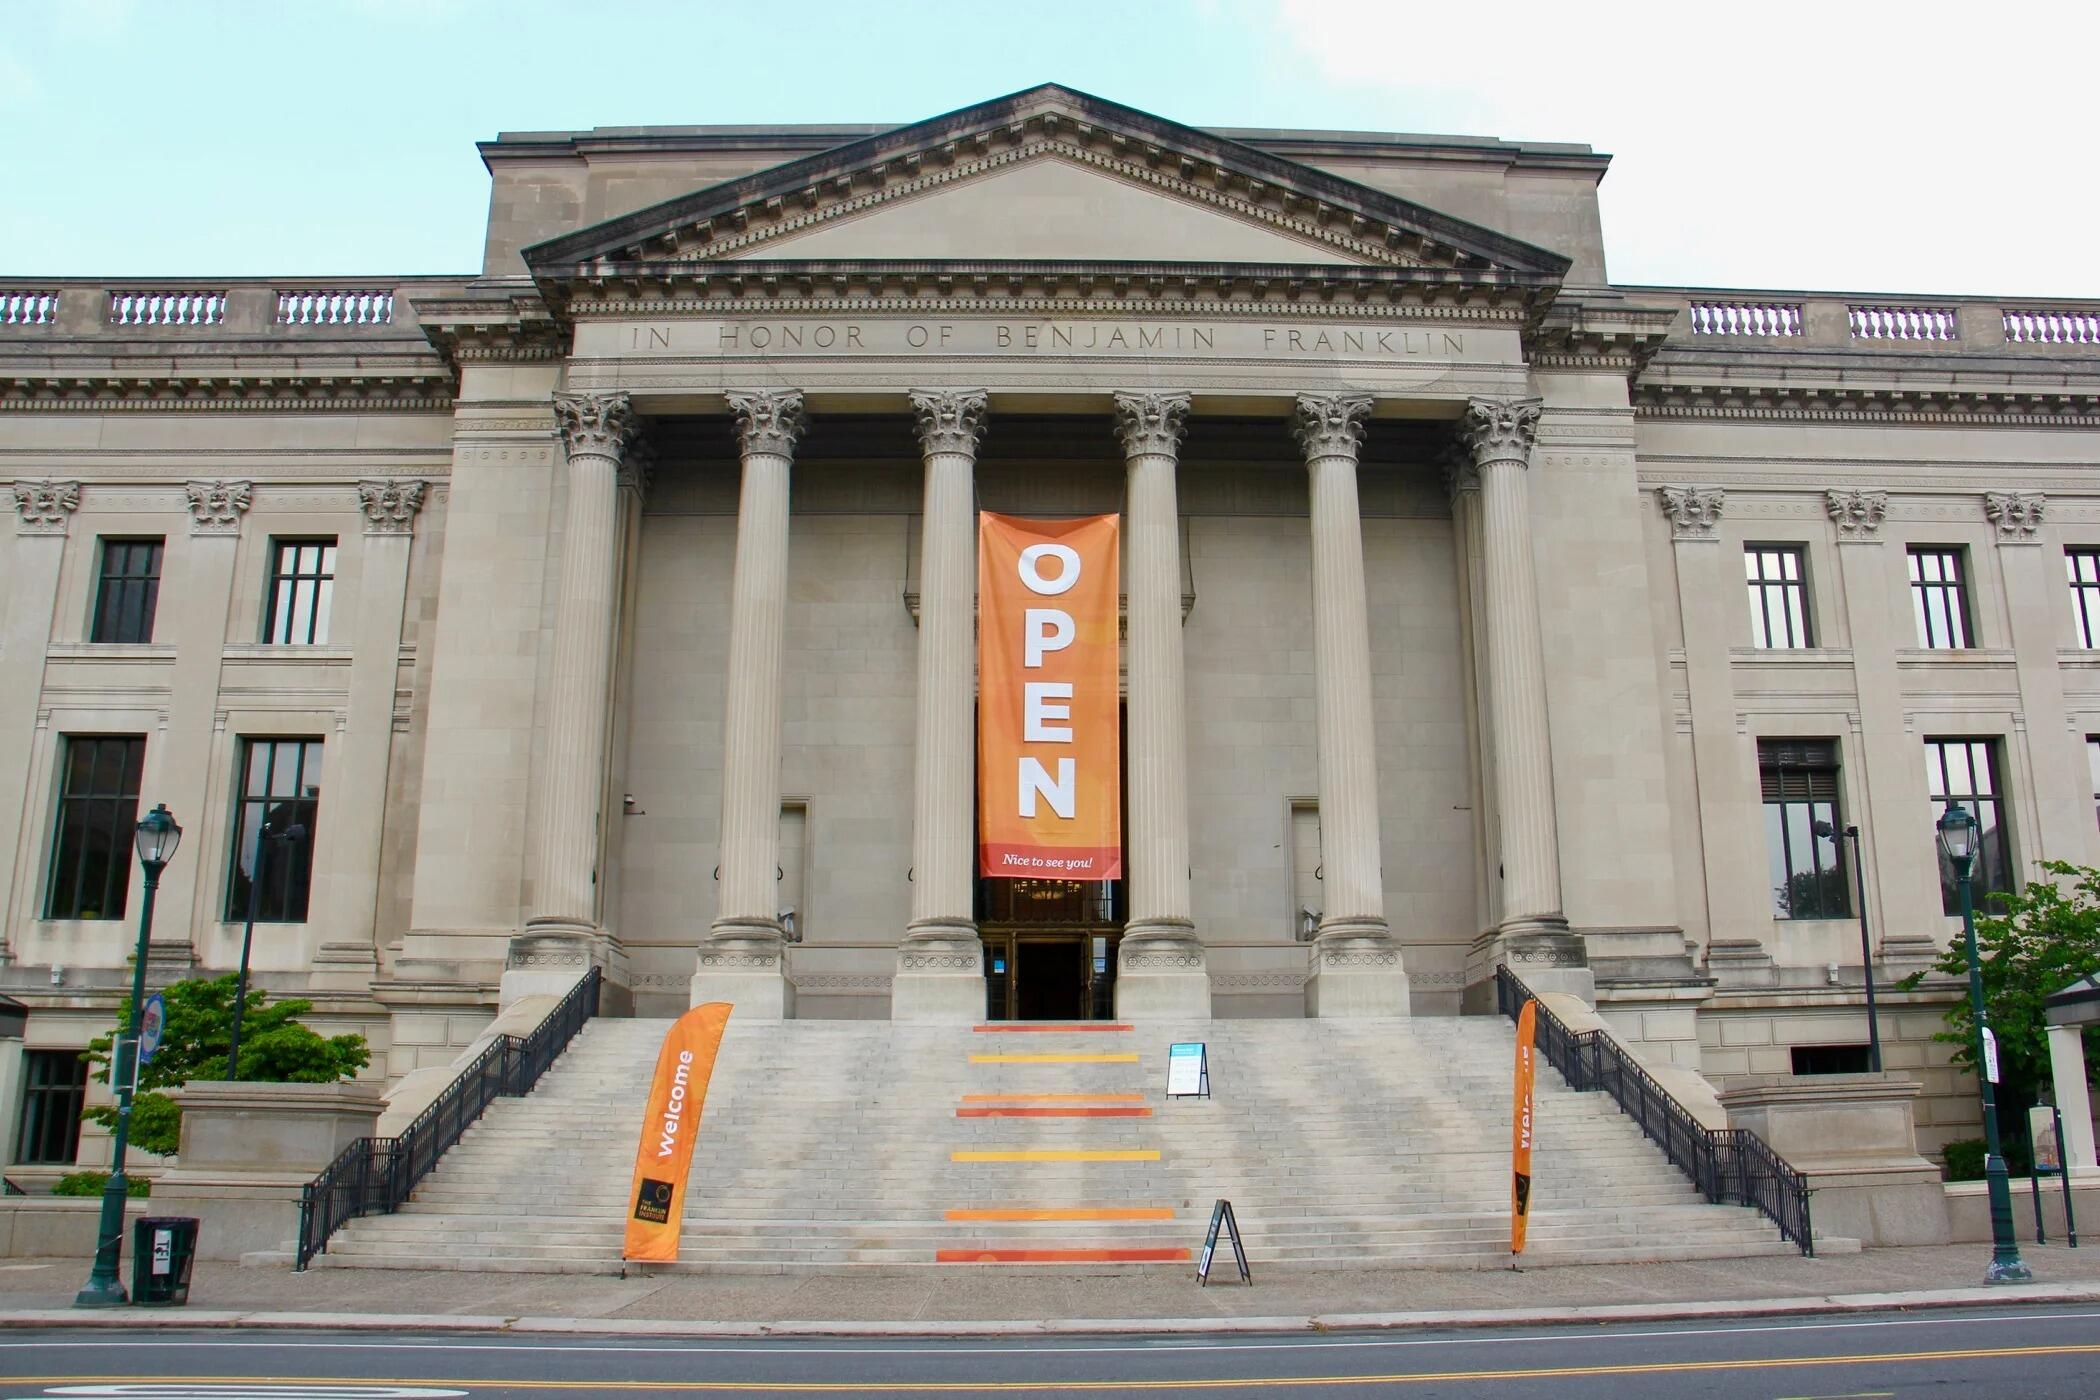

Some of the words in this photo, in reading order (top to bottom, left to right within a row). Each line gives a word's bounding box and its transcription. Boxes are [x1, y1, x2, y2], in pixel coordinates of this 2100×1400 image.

[632, 327, 671, 349] IN
[719, 325, 865, 348] HONOR
[906, 325, 953, 347] OF
[996, 325, 1215, 349] BENJAMIN
[1263, 329, 1464, 354] FRANKLIN
[1018, 543, 1081, 819] OPEN
[1002, 853, 1030, 866] Nice
[1031, 857, 1043, 867] to
[1045, 859, 1064, 868] see
[1066, 857, 1093, 871] you!
